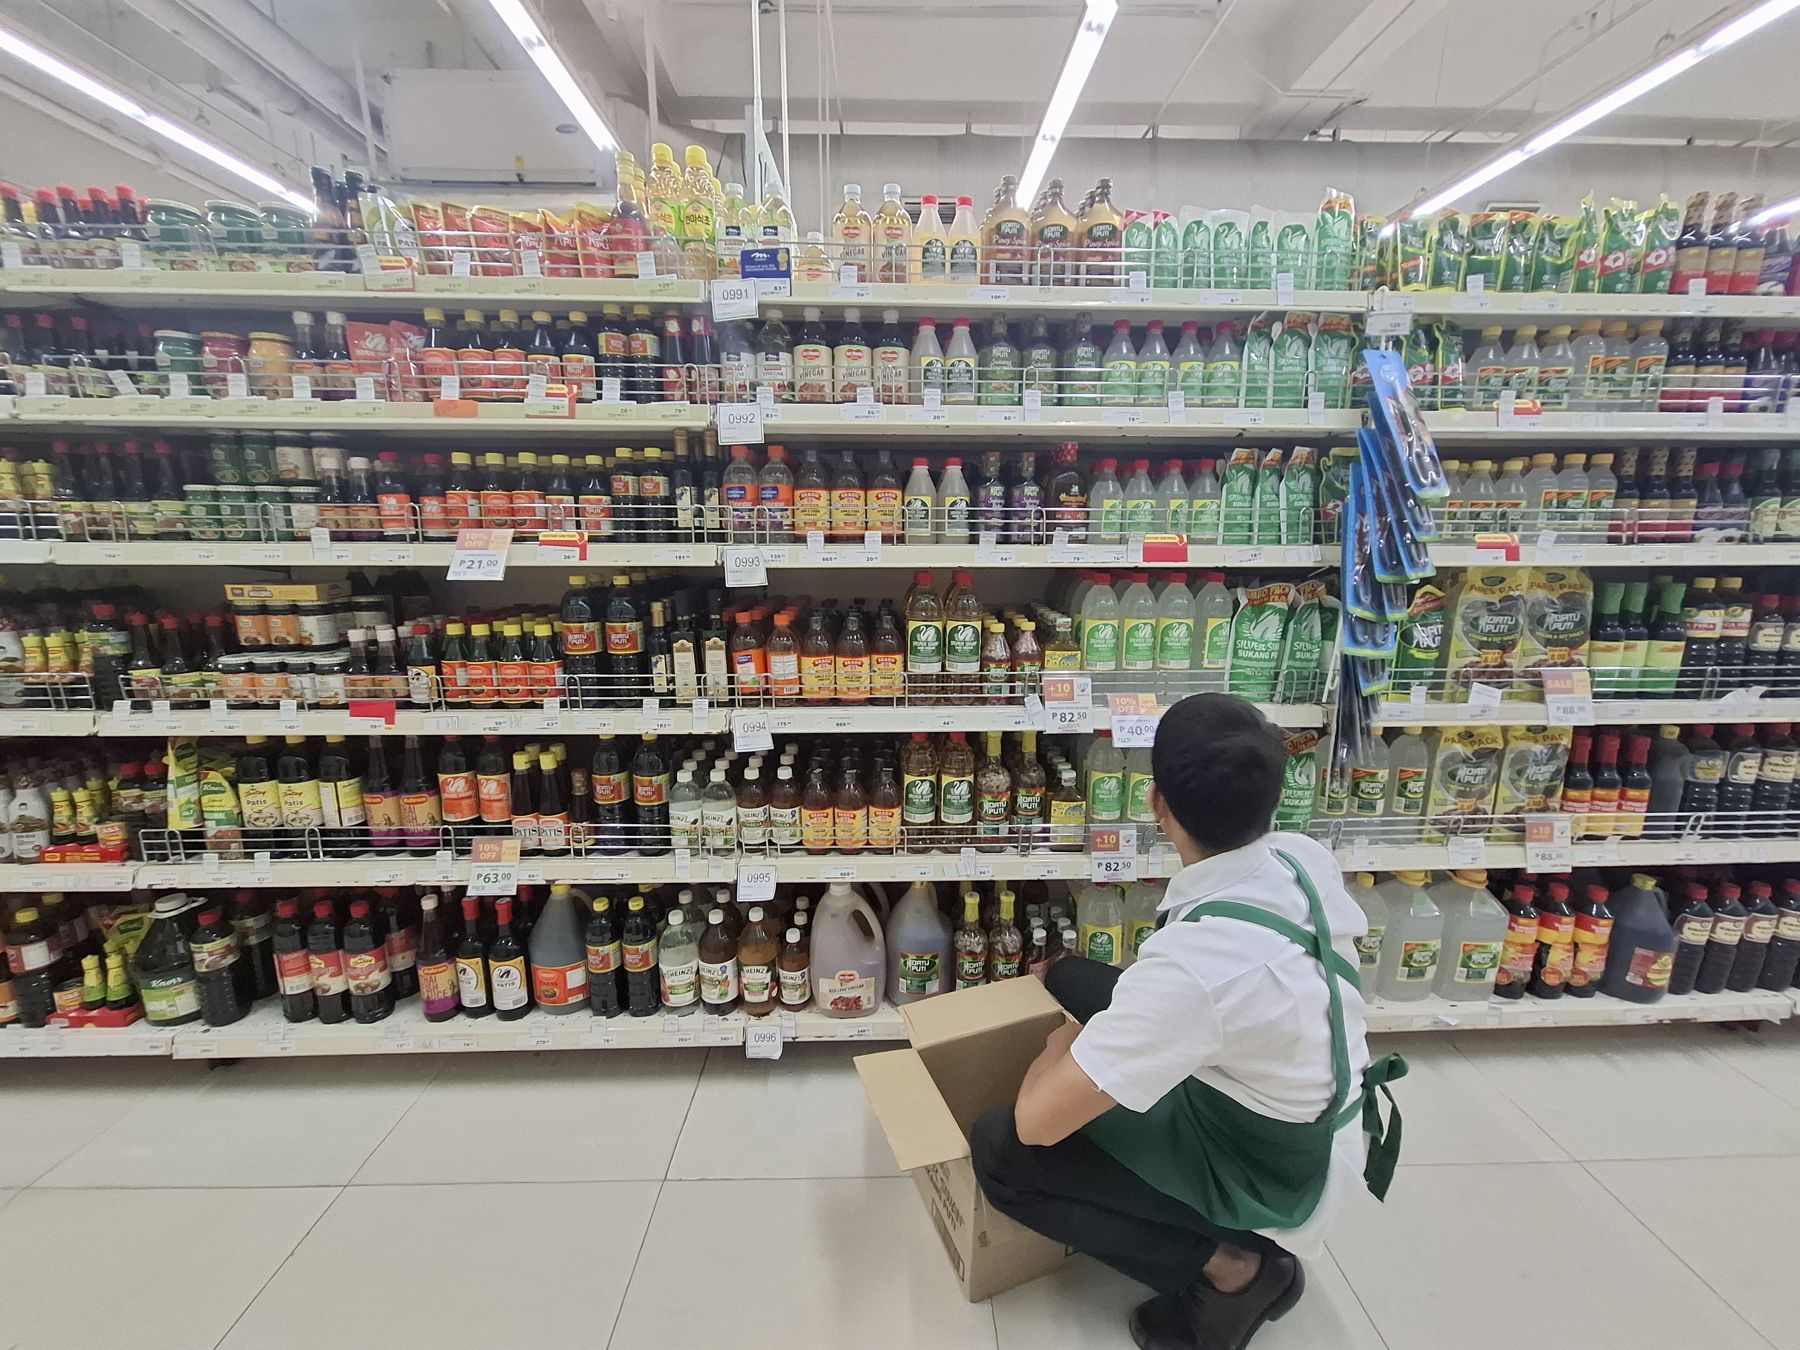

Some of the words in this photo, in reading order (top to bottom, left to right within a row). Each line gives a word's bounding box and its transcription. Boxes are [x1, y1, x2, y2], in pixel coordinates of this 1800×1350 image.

[840, 248, 865, 258] VINEGAR
[882, 248, 907, 259] VINGAR
[722, 288, 749, 301] 0991
[799, 369, 825, 379] VINEGAR
[842, 369, 867, 379] VINEGAR
[728, 412, 755, 425] 0992
[735, 556, 760, 567] 0993
[1486, 615, 1515, 625] DATU
[1552, 613, 1581, 622] DATU
[1486, 624, 1508, 633] PUTI
[1551, 622, 1574, 631] PUTI
[1236, 640, 1266, 652] SILVER
[1238, 650, 1270, 660] SUKANG
[1049, 683, 1069, 693] +10
[1547, 679, 1573, 689] SALE
[1115, 696, 1135, 705] 10%
[1118, 705, 1134, 713] OFF
[743, 722, 766, 733] 0994
[1020, 796, 1041, 804] DATU
[514, 826, 538, 837] PATIS
[540, 826, 563, 837] PATIS
[1532, 826, 1551, 834] +10
[1095, 835, 1116, 844] +10
[480, 843, 499, 852] 10%
[480, 852, 496, 860] OFF
[747, 872, 771, 883] 0995
[966, 960, 985, 968] DATU
[669, 969, 691, 978] HEINZ
[150, 976, 183, 988] Knorr
[754, 1032, 776, 1044] 0996
